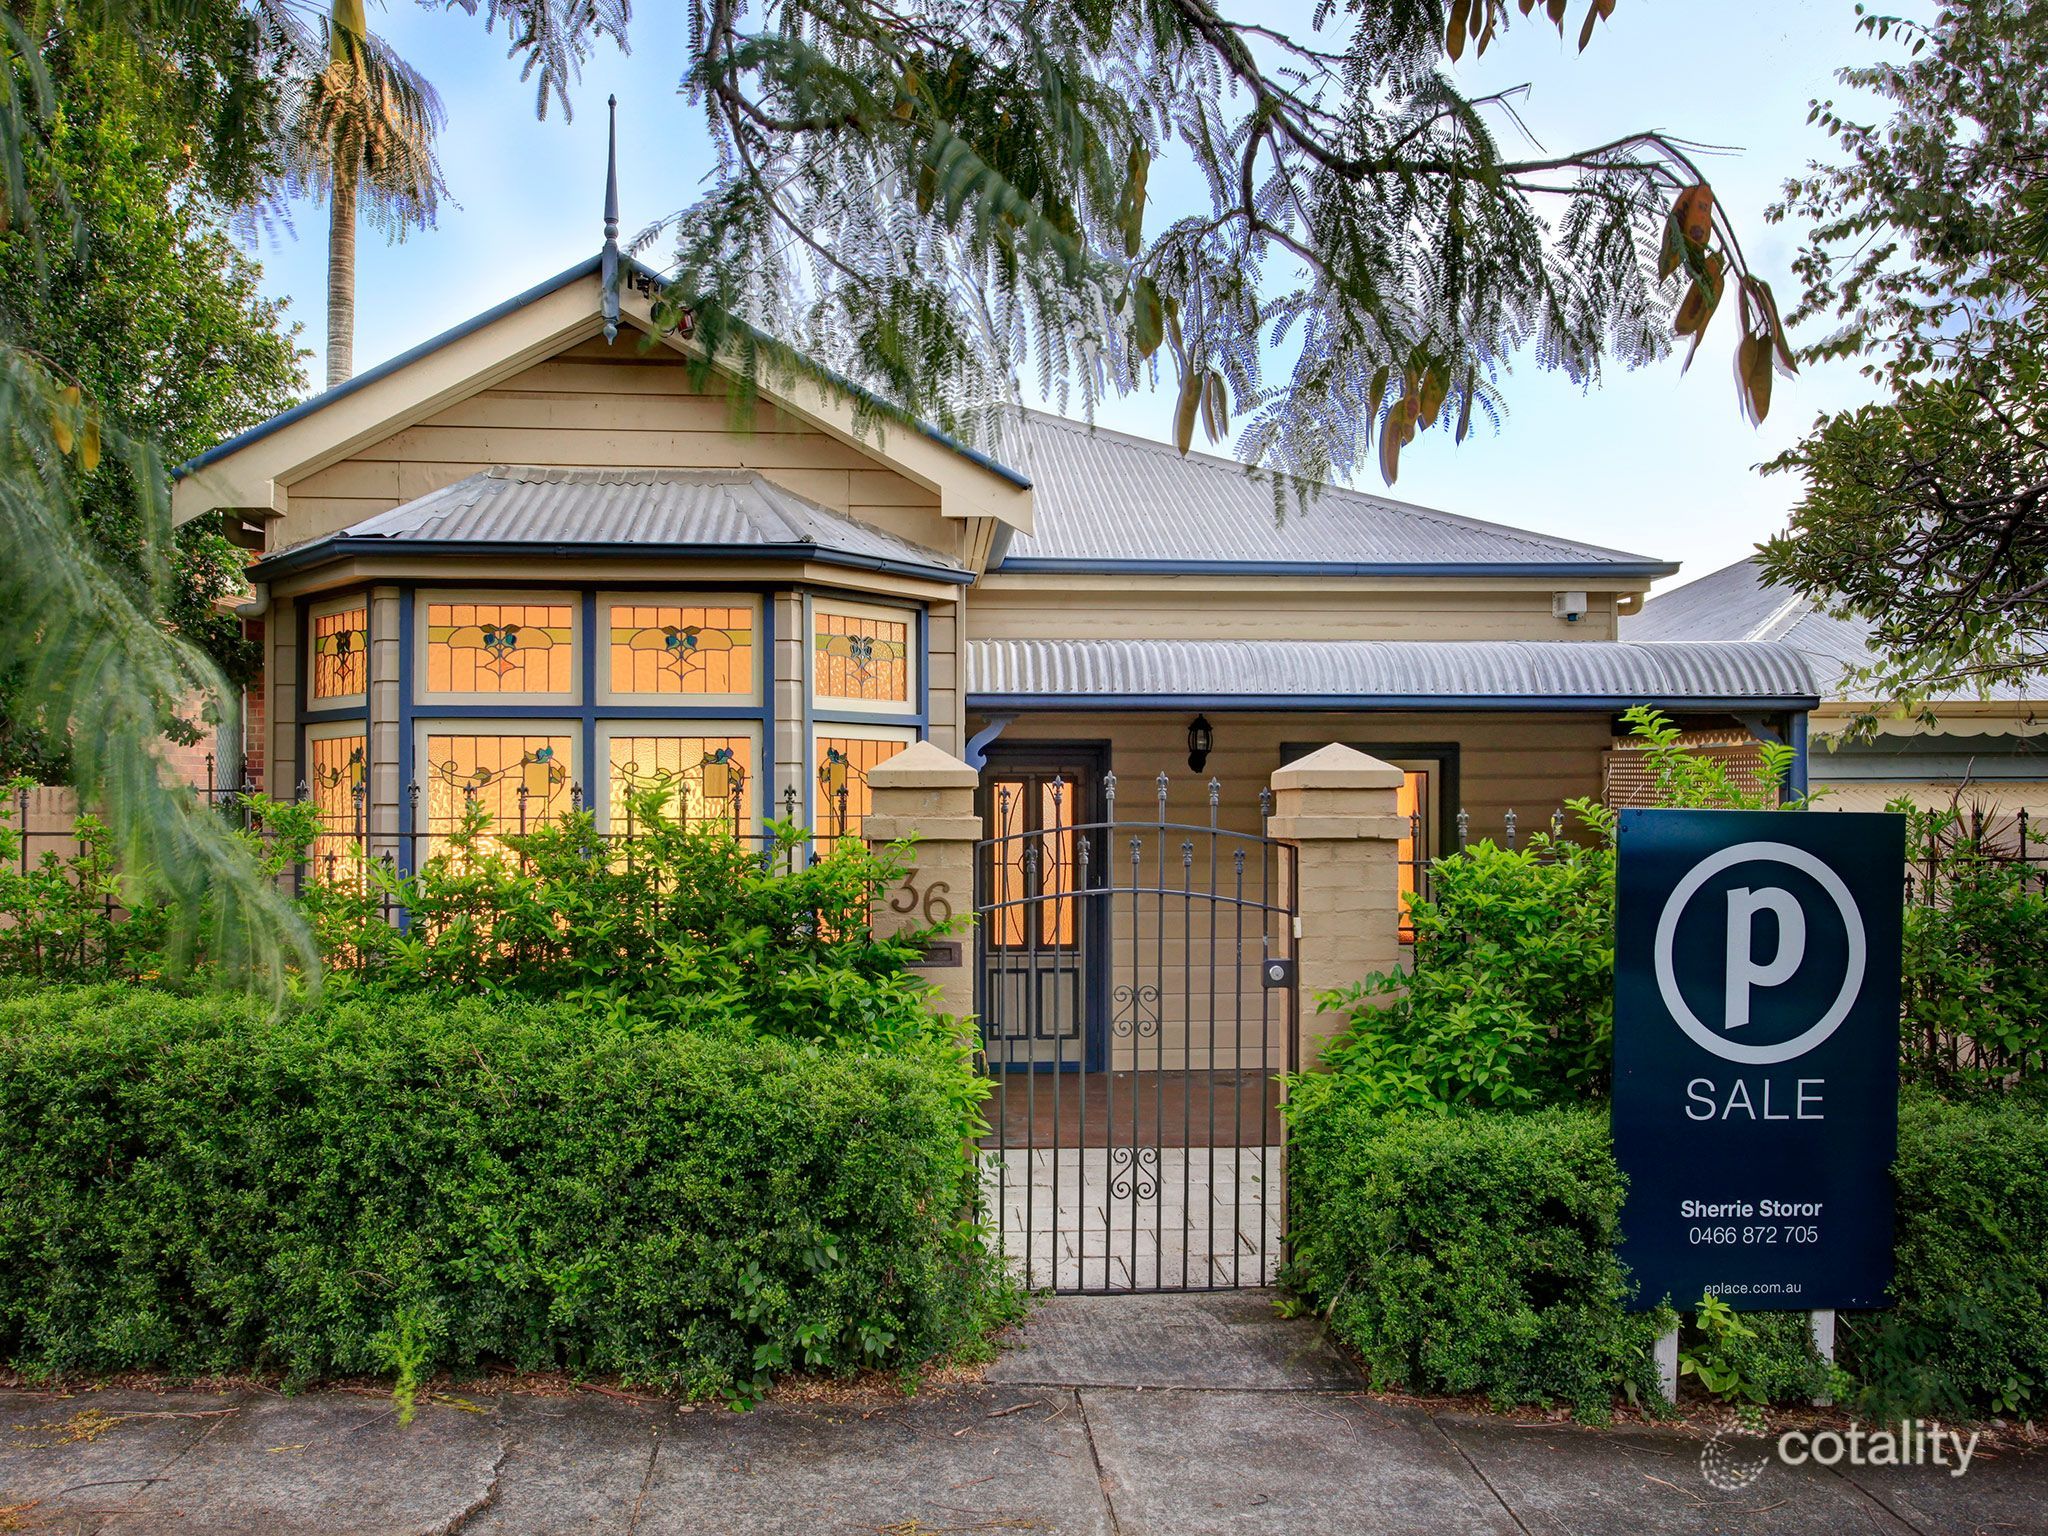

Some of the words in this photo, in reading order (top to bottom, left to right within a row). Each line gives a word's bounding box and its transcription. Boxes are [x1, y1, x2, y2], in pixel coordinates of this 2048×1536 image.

[891, 868, 952, 926] 36
[1685, 1077, 1825, 1121] SALE
[1680, 1199, 1754, 1218] Sherrie
[1759, 1199, 1823, 1217] Storor
[1689, 1226, 1737, 1245] 0466
[1742, 1226, 1778, 1244] 872
[1784, 1225, 1819, 1243] 705
[1703, 1282, 1802, 1297] eplace.com.au
